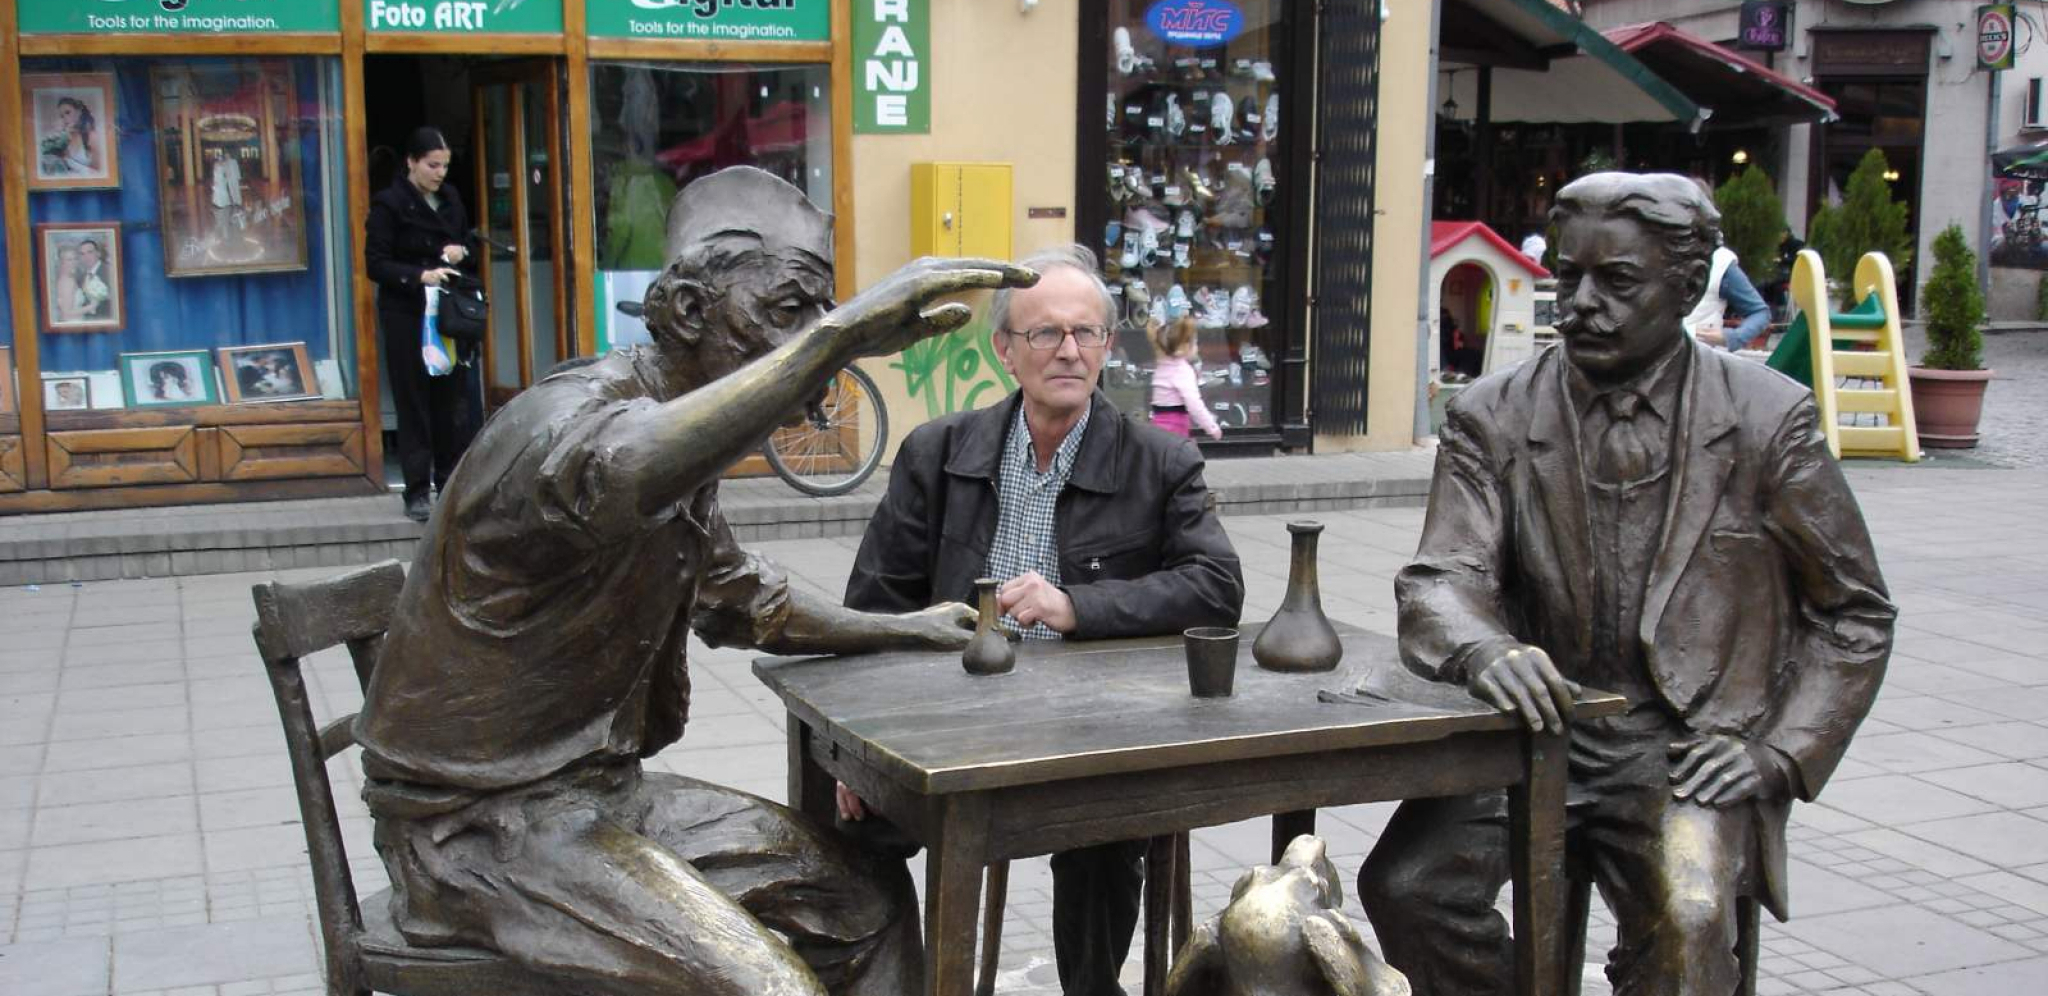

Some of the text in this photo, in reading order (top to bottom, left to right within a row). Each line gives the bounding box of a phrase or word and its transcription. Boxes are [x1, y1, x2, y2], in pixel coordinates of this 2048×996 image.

[88, 15, 279, 31] Tools for the imagination.
[370, 1, 487, 30] Foto ART
[629, 20, 797, 38] Tools for the imagination.
